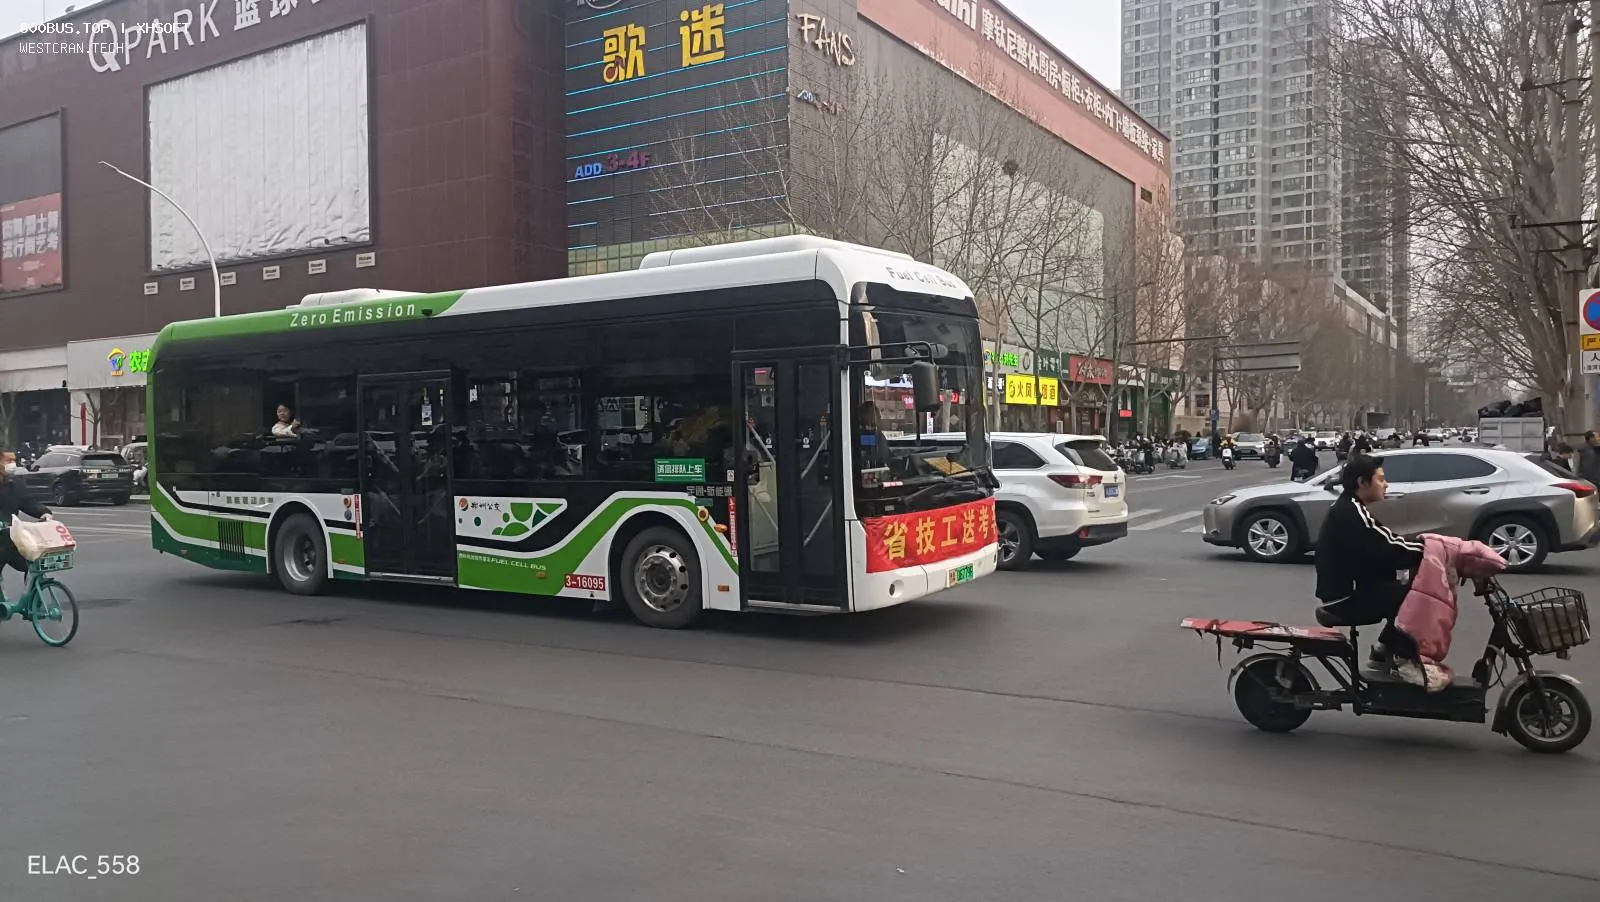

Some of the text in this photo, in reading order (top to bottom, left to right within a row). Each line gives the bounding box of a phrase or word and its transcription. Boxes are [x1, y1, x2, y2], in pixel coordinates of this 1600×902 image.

[89, 3, 221, 73] QPARK
[602, 3, 725, 83] 歌迷
[797, 13, 855, 66] FANS
[575, 163, 602, 178] ADD
[290, 303, 415, 327] Zero Emission
[1017, 381, 1056, 400] 火凤烟酒
[490, 557, 509, 566] FUEL
[510, 560, 529, 569] CELL
[530, 563, 547, 571] BUS
[565, 574, 605, 590] 3-16095
